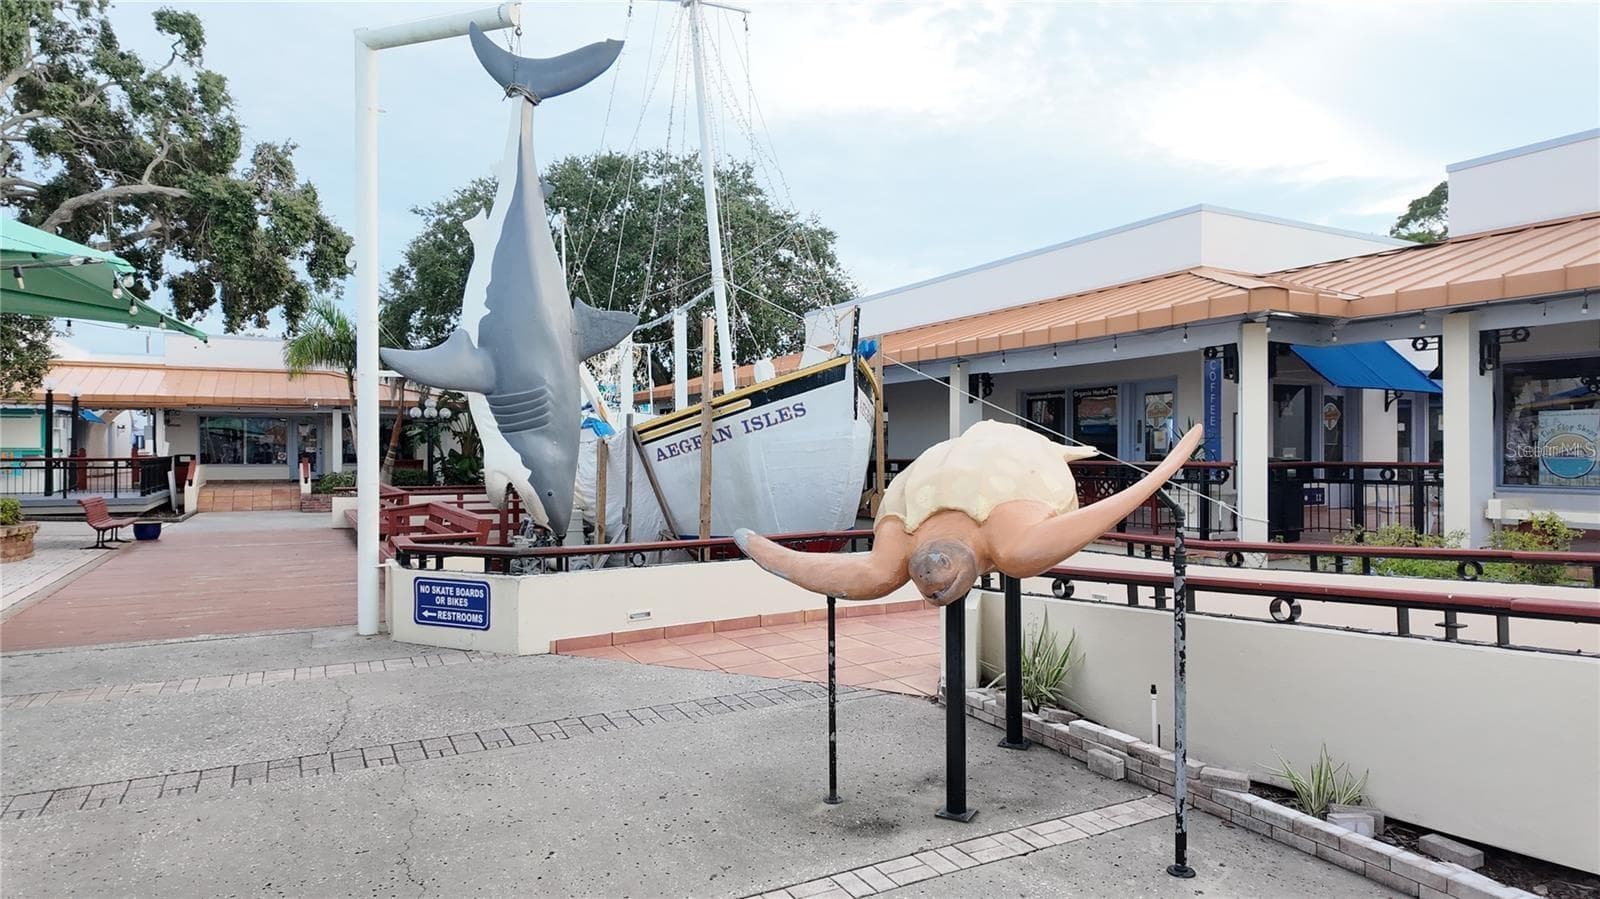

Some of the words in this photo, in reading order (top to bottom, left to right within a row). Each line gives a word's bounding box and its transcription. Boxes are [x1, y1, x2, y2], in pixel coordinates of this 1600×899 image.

[1209, 360, 1217, 426] COFFEE
[740, 402, 807, 434] ISLES
[420, 585, 430, 594] NO
[431, 585, 454, 596] SKATE
[455, 587, 484, 599] BOARDS
[435, 596, 445, 605] OR
[446, 597, 469, 607] BIKES
[437, 610, 483, 623] RESTROOMS
